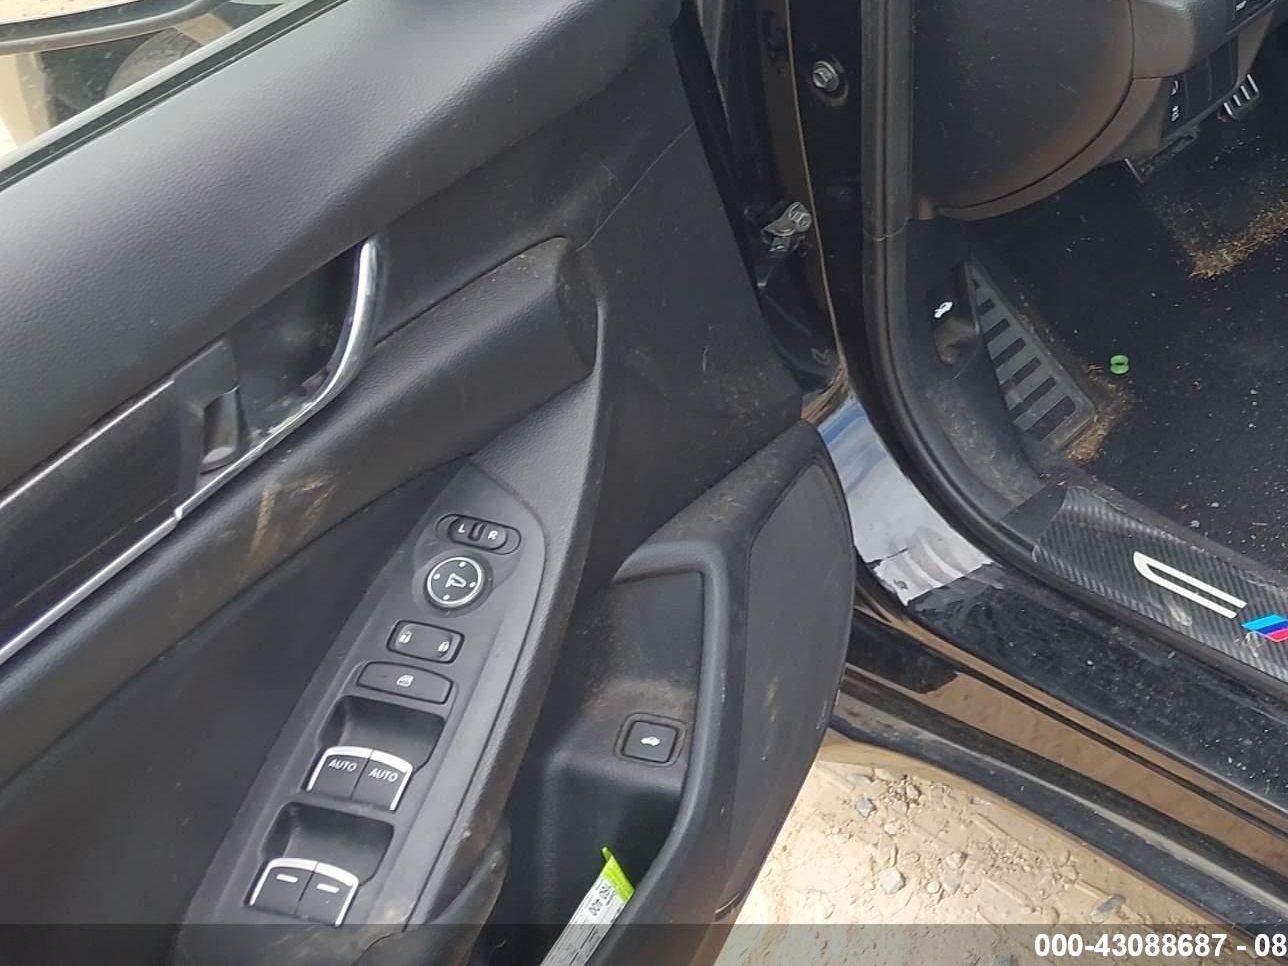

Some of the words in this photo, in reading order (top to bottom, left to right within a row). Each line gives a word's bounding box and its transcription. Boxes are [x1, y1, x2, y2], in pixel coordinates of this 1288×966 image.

[458, 523, 465, 533] L
[487, 530, 499, 540] R
[328, 758, 358, 772] AUTO
[368, 767, 399, 782] AUTO
